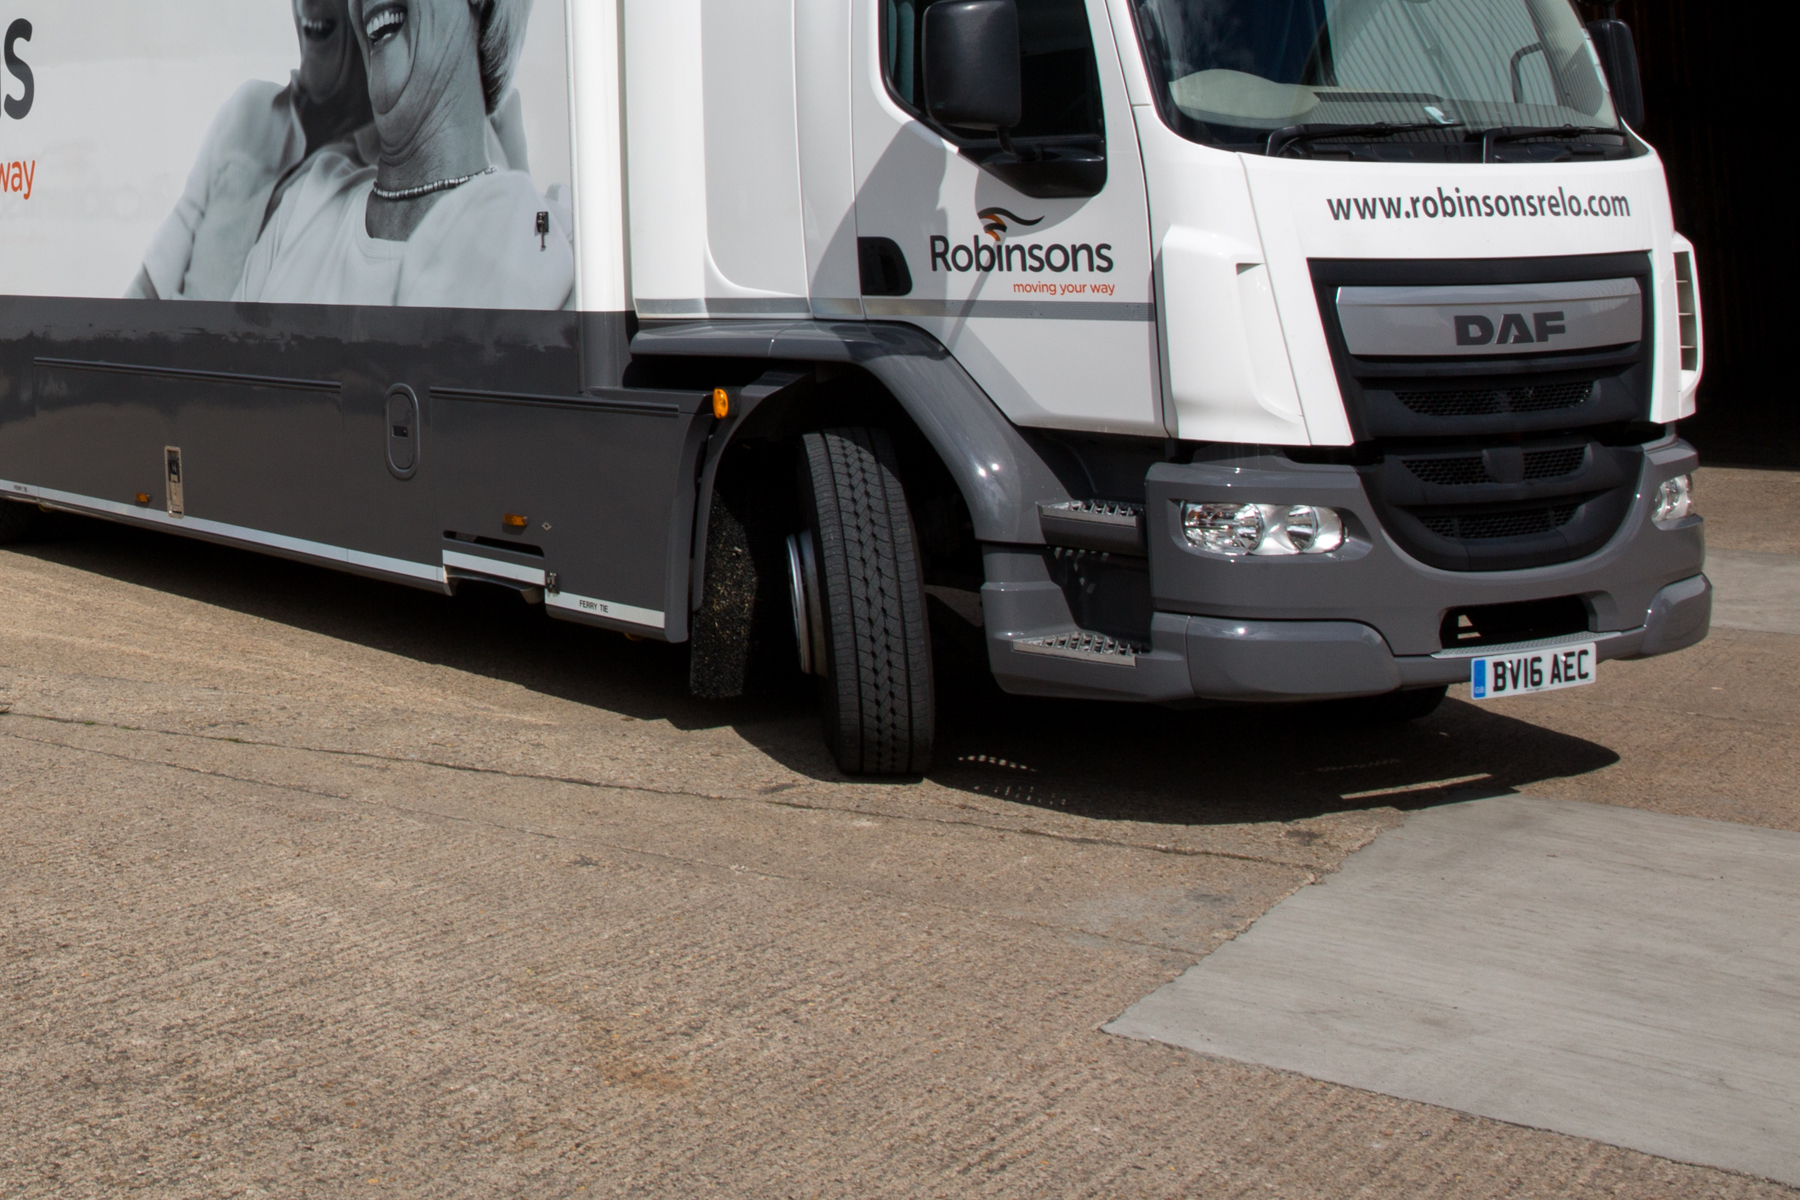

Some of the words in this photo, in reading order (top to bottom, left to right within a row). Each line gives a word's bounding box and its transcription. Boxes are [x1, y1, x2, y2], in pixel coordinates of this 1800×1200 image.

[1326, 186, 1631, 221] www.robinsonsrelo.com
[929, 235, 1114, 273] Robinsons
[1013, 281, 1057, 295] moving
[1059, 283, 1087, 296] your
[1089, 284, 1115, 296] way
[1453, 311, 1567, 346] DAF
[579, 599, 597, 611] FERRY
[1492, 656, 1543, 693] BV16
[1550, 649, 1589, 685] AEC
